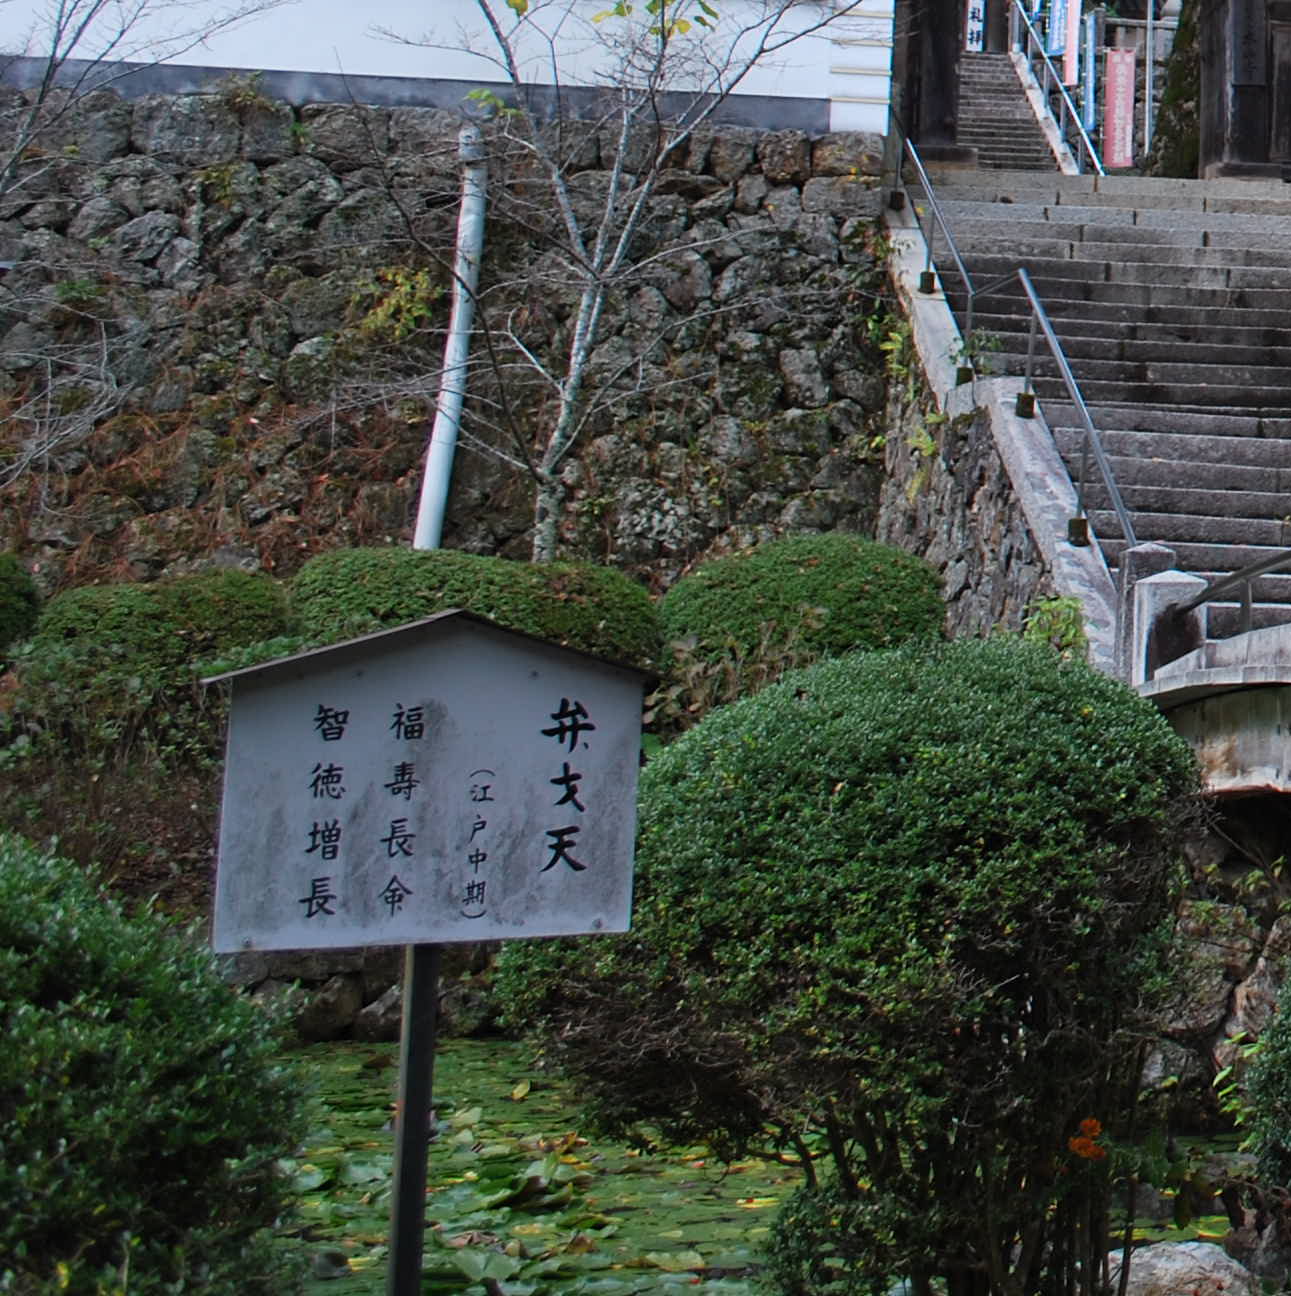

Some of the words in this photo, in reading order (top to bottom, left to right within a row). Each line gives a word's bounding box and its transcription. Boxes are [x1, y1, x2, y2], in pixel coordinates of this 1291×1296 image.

[299, 704, 350, 918] 智徳増長
[541, 697, 595, 872] 弁才天
